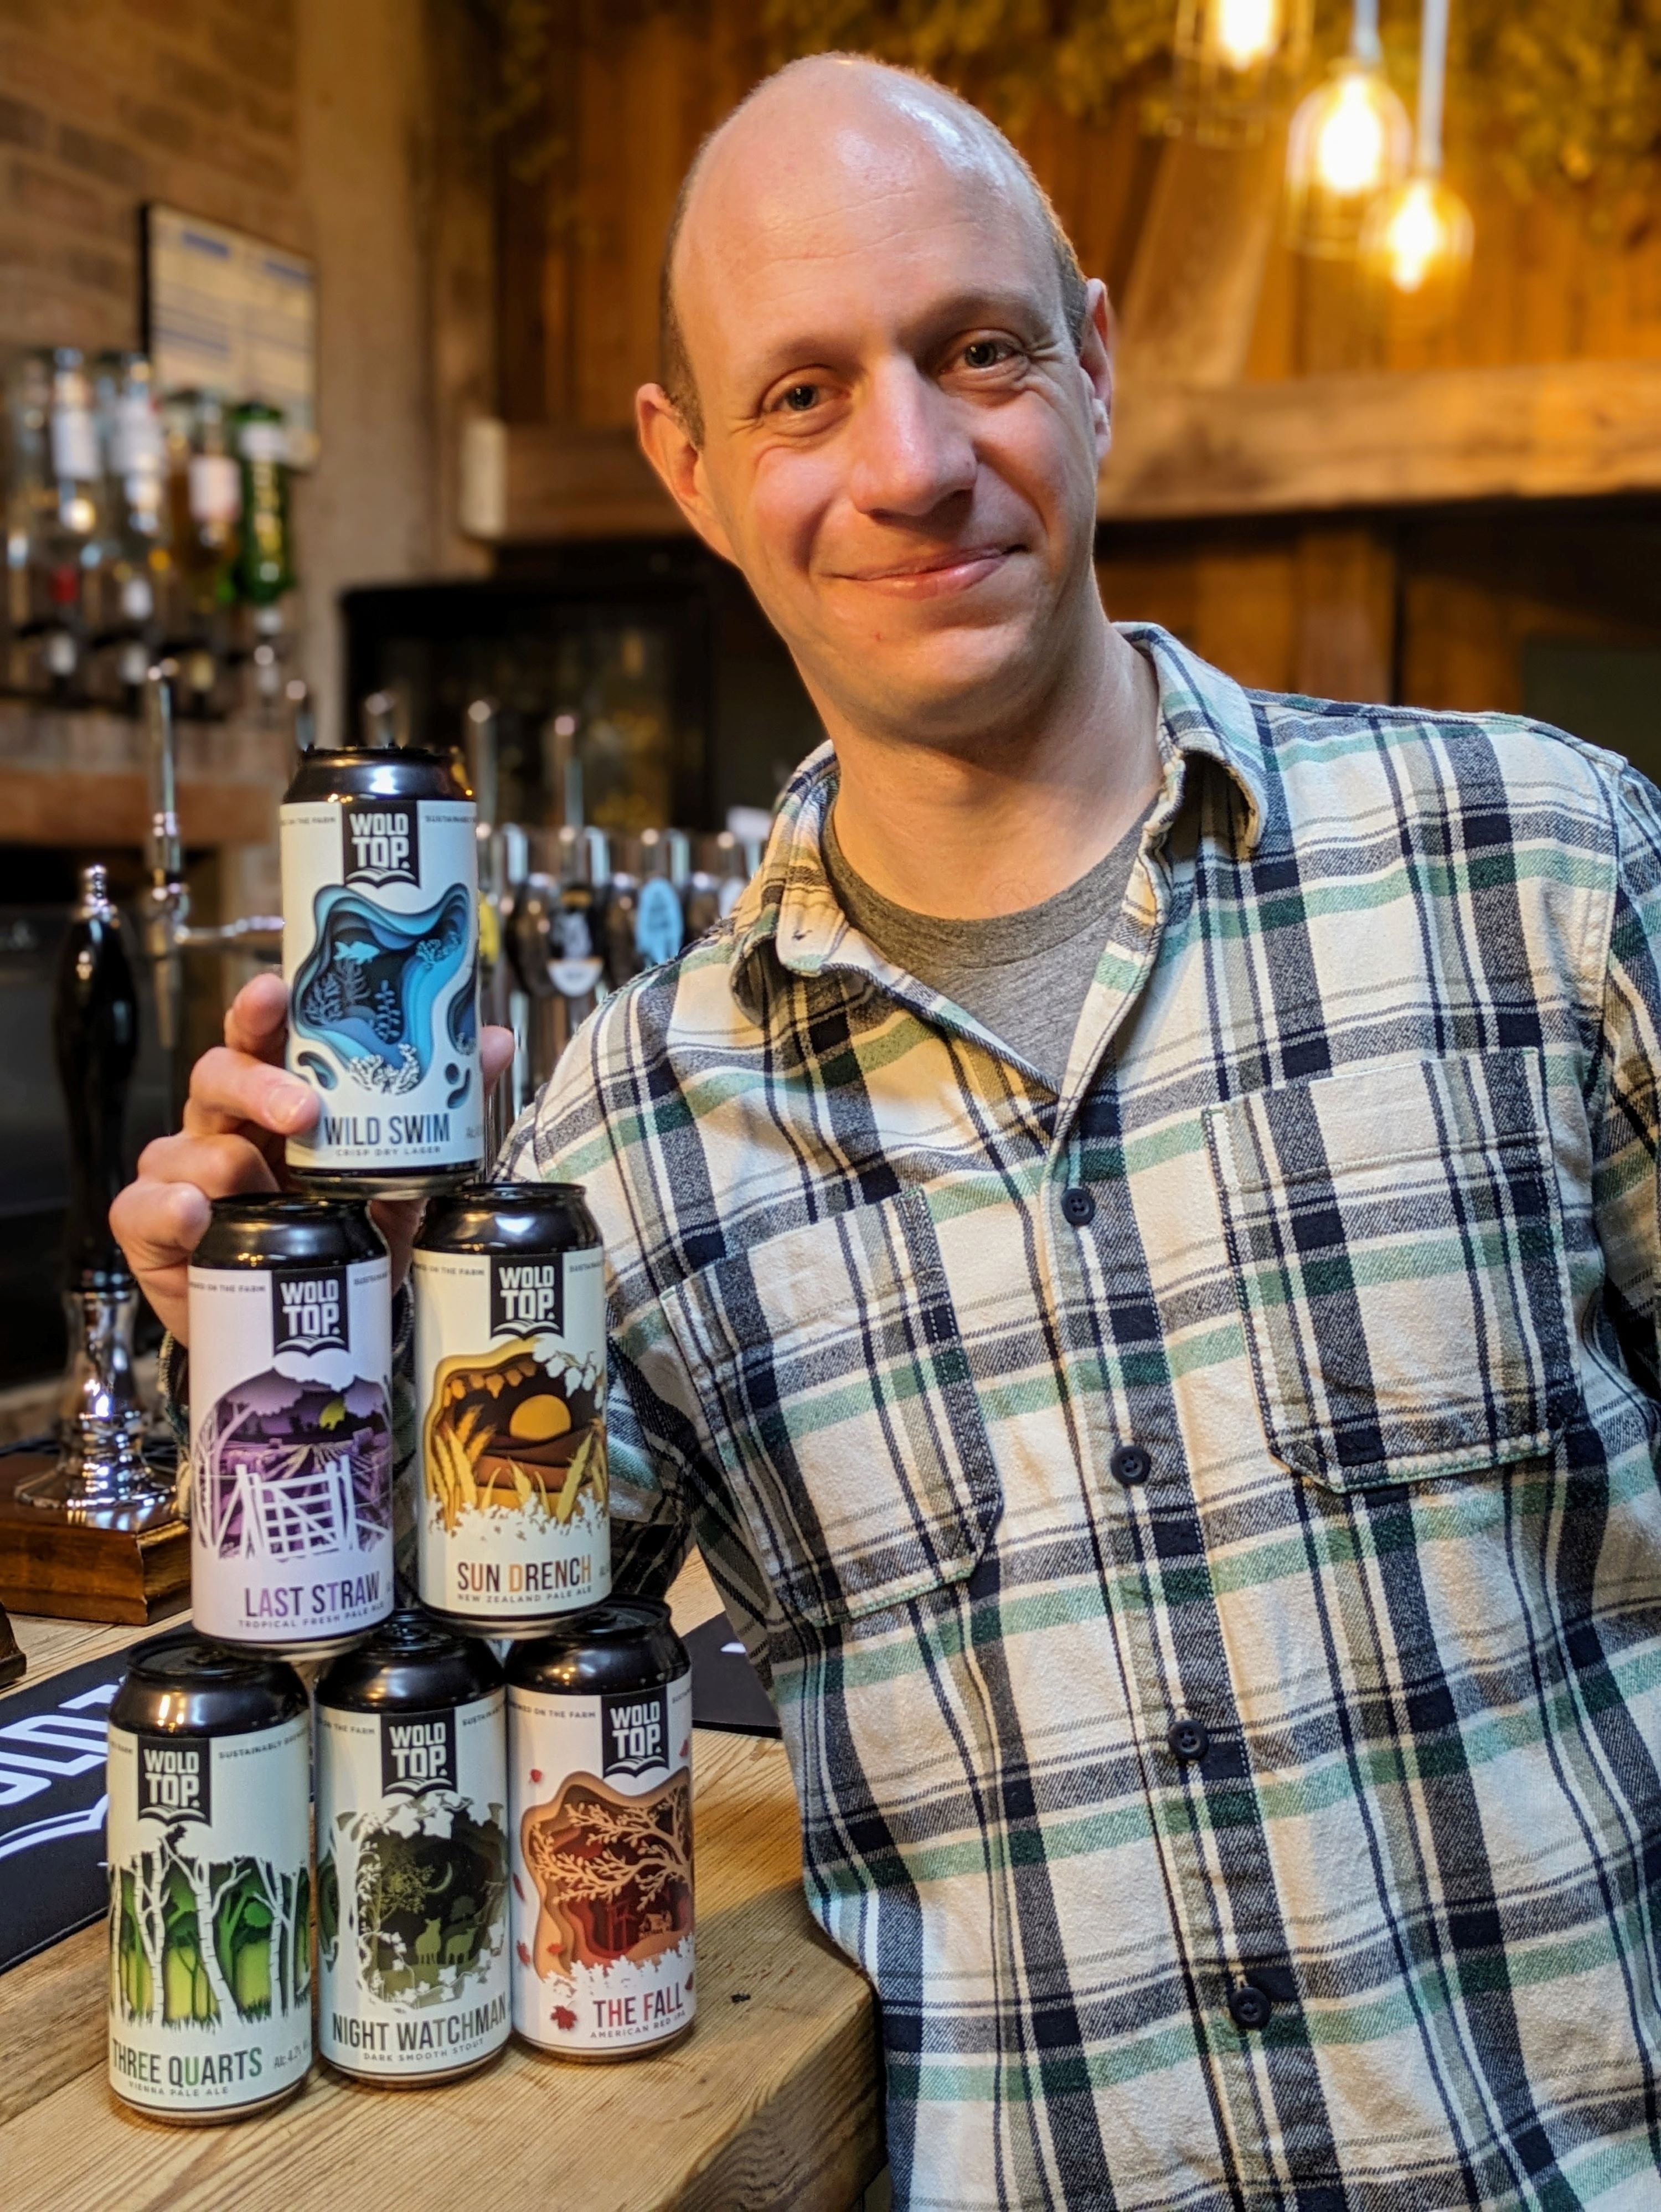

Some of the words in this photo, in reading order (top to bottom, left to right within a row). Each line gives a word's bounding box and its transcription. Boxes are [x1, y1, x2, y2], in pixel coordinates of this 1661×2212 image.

[349, 813, 409, 836] WOLD
[324, 1116, 381, 1146] WILD
[389, 1112, 450, 1145] SWIM
[404, 1146, 441, 1155] LAGER
[498, 1265, 554, 1289] WOLD
[280, 1278, 339, 1305] WOLD
[457, 1561, 501, 1592] SUN
[509, 1554, 591, 1592] DRENCH
[245, 1586, 304, 1617] LAST
[312, 1570, 380, 1615] STRAW
[457, 1594, 481, 1602] NEW
[486, 1594, 541, 1603] ZEALAND
[547, 1591, 572, 1601] PALE
[239, 1620, 297, 1628] TROPICAL
[549, 1709, 566, 1718] THE
[610, 1700, 661, 1730] WOLD
[389, 1721, 446, 1748] WOLD
[143, 1749, 199, 1774] WOLD
[592, 1996, 637, 2028] THE
[643, 1981, 684, 2022] FALL
[332, 2012, 390, 2051] NIGHT
[396, 1992, 507, 2051] WATCHMAN
[590, 2024, 649, 2039] AMERICAN
[653, 2018, 672, 2029] RED
[363, 2052, 393, 2062] DARK
[399, 2049, 448, 2062] SMOOTH
[452, 2038, 484, 2055] STOUT
[112, 2038, 162, 2084] THREE
[168, 2046, 262, 2088] QUARTS
[128, 2080, 165, 2095] VIENNA
[170, 2088, 200, 2097] PALE
[205, 2086, 229, 2096] ALE
